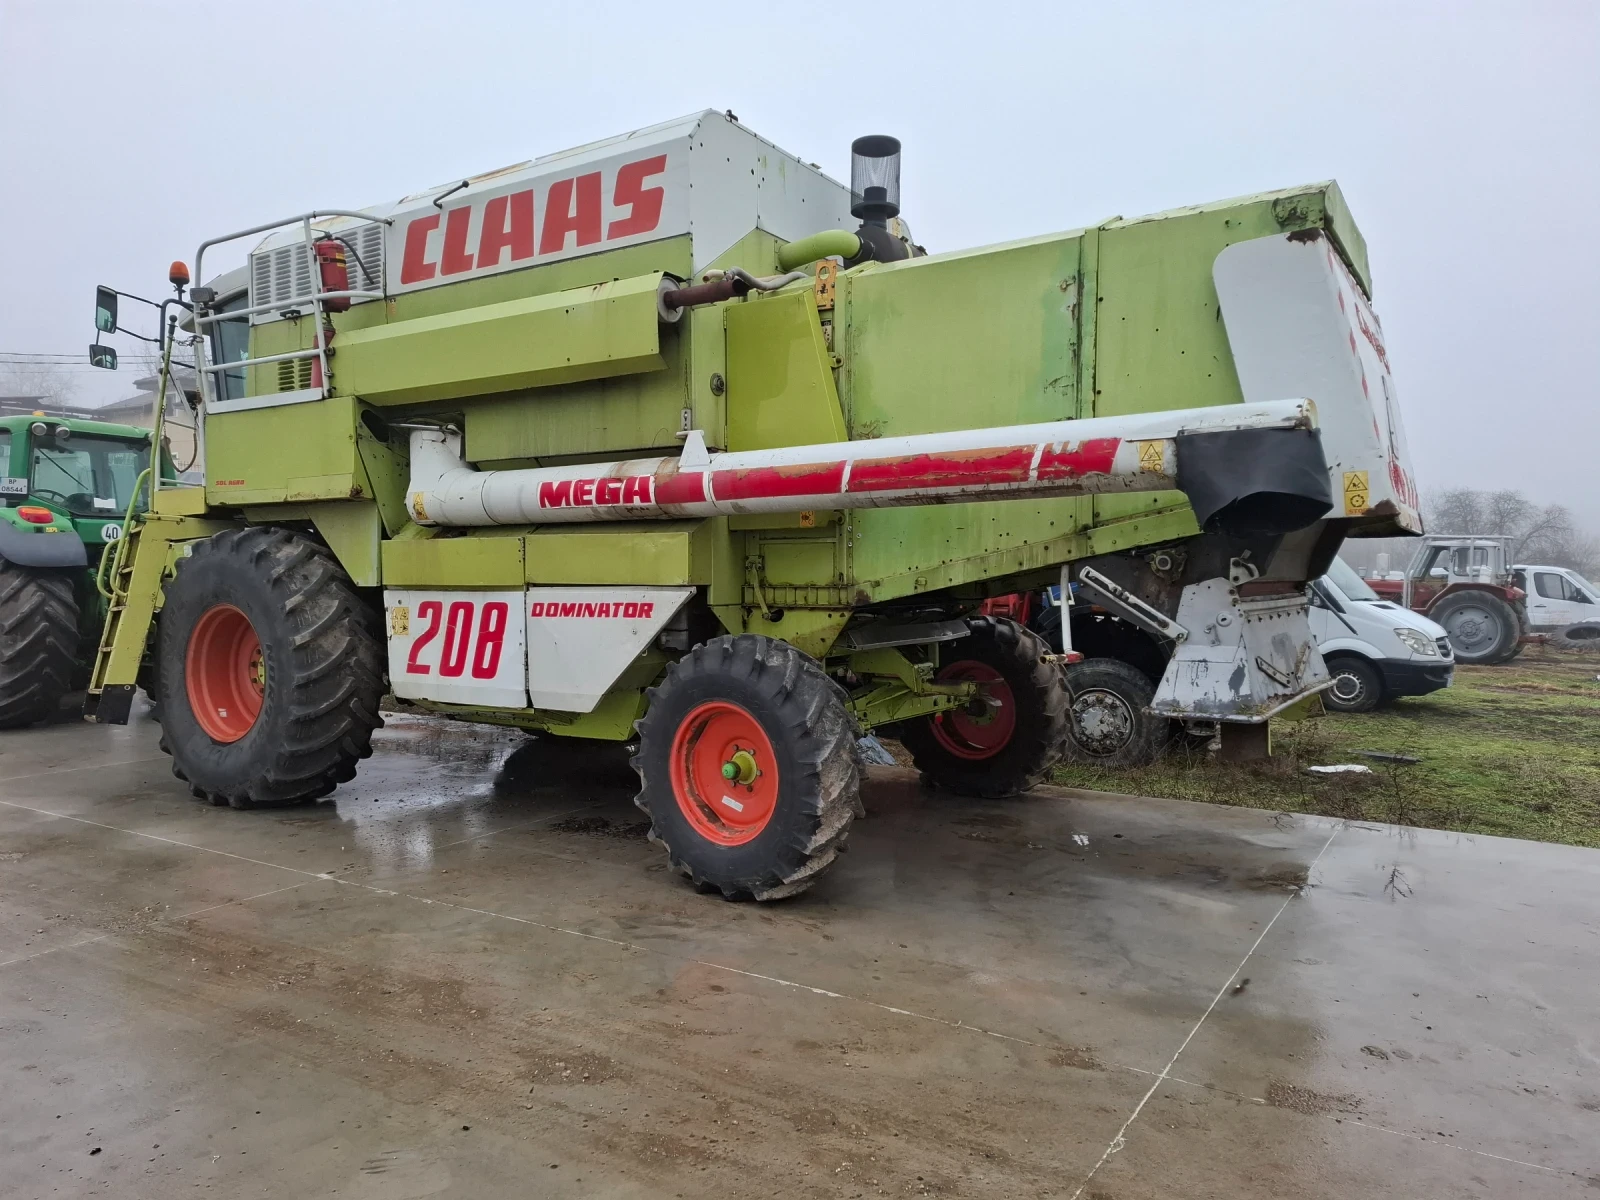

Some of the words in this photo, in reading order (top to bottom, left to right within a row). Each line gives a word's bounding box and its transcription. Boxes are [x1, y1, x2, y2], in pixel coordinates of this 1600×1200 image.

[400, 154, 668, 285] CLAAS
[539, 475, 653, 508] MEGA
[105, 526, 119, 540] 40
[531, 602, 654, 619] DOMINATOR
[406, 600, 509, 680] 208
